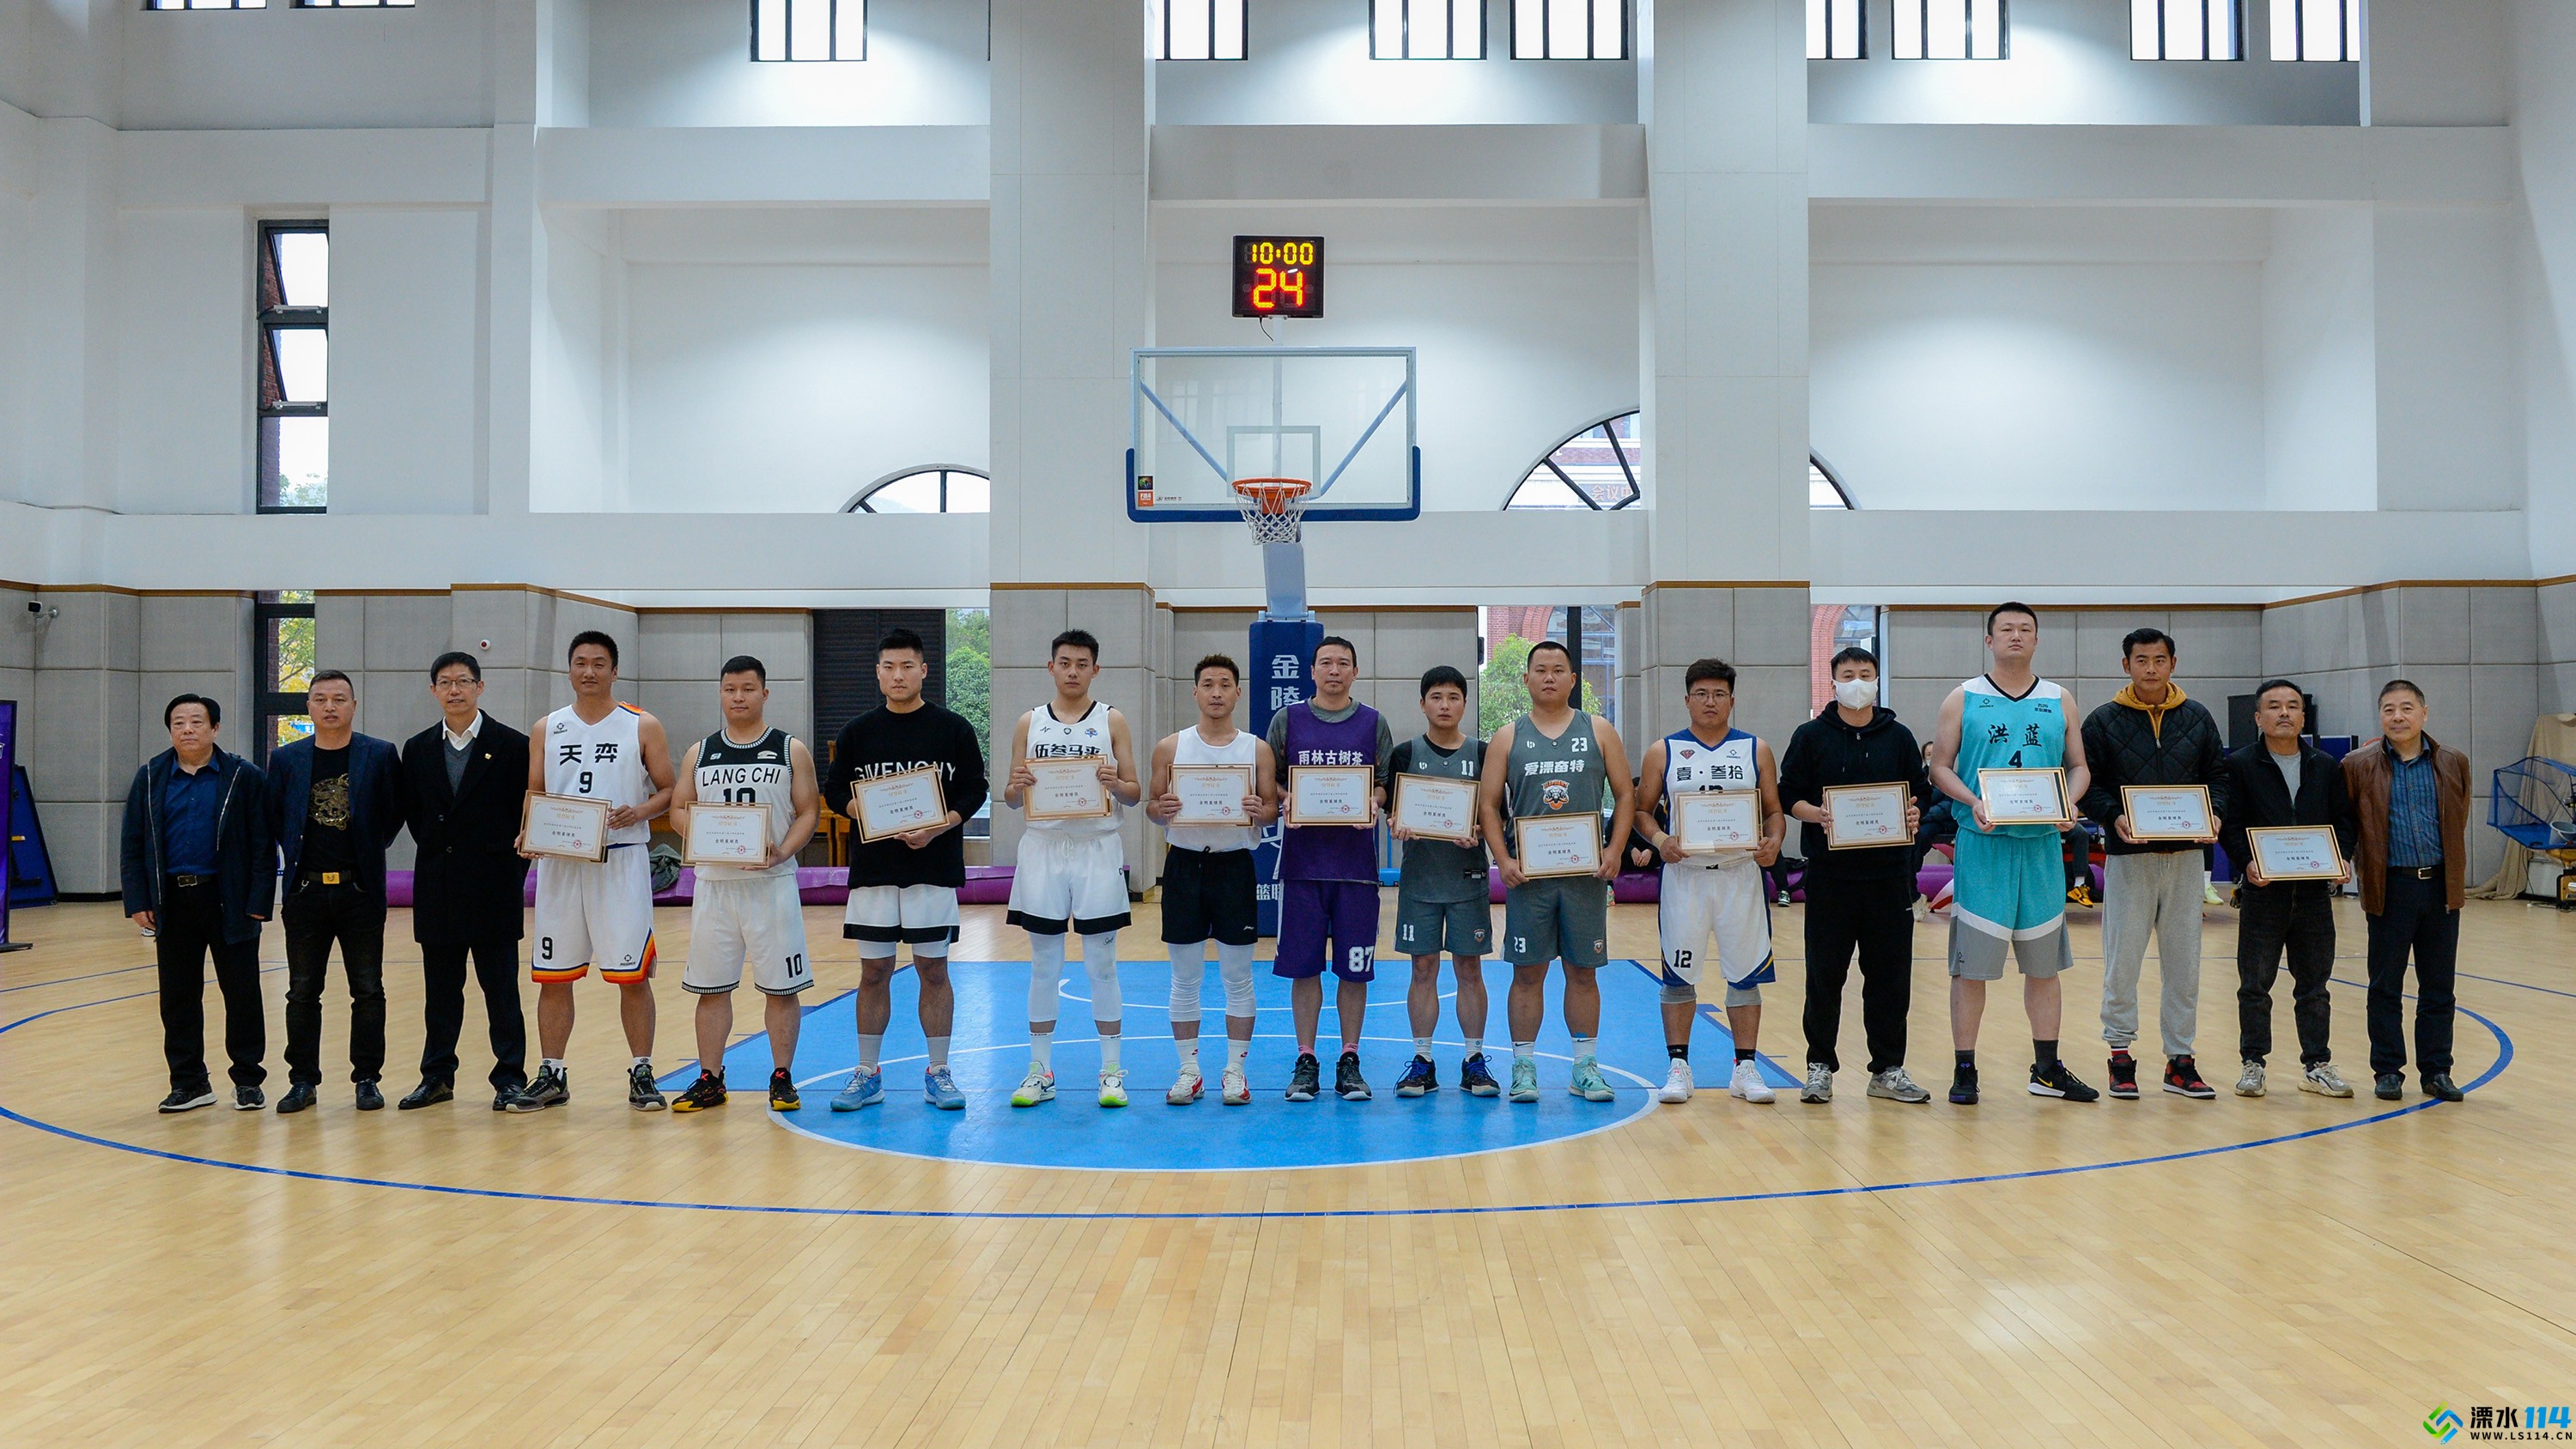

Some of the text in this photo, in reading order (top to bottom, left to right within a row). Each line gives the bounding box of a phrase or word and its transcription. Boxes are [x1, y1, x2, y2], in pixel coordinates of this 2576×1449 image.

[1251, 241, 1314, 265] 10:00
[1253, 268, 1303, 308] 24
[1271, 654, 1301, 711] 金陵
[1571, 737, 1589, 753] 23
[1987, 723, 2043, 748] 洪蓝
[559, 743, 618, 767] 天弈
[1297, 749, 1364, 766] 雨林古树茶
[2008, 749, 2023, 769] 4
[702, 767, 781, 787] LANG CHI
[1461, 760, 1474, 777] 11
[579, 771, 593, 794] 9
[1402, 924, 1415, 942] 11
[541, 936, 553, 961] 9
[1348, 945, 1375, 973] 87
[1674, 949, 1692, 968] 12
[785, 953, 803, 979] 10
